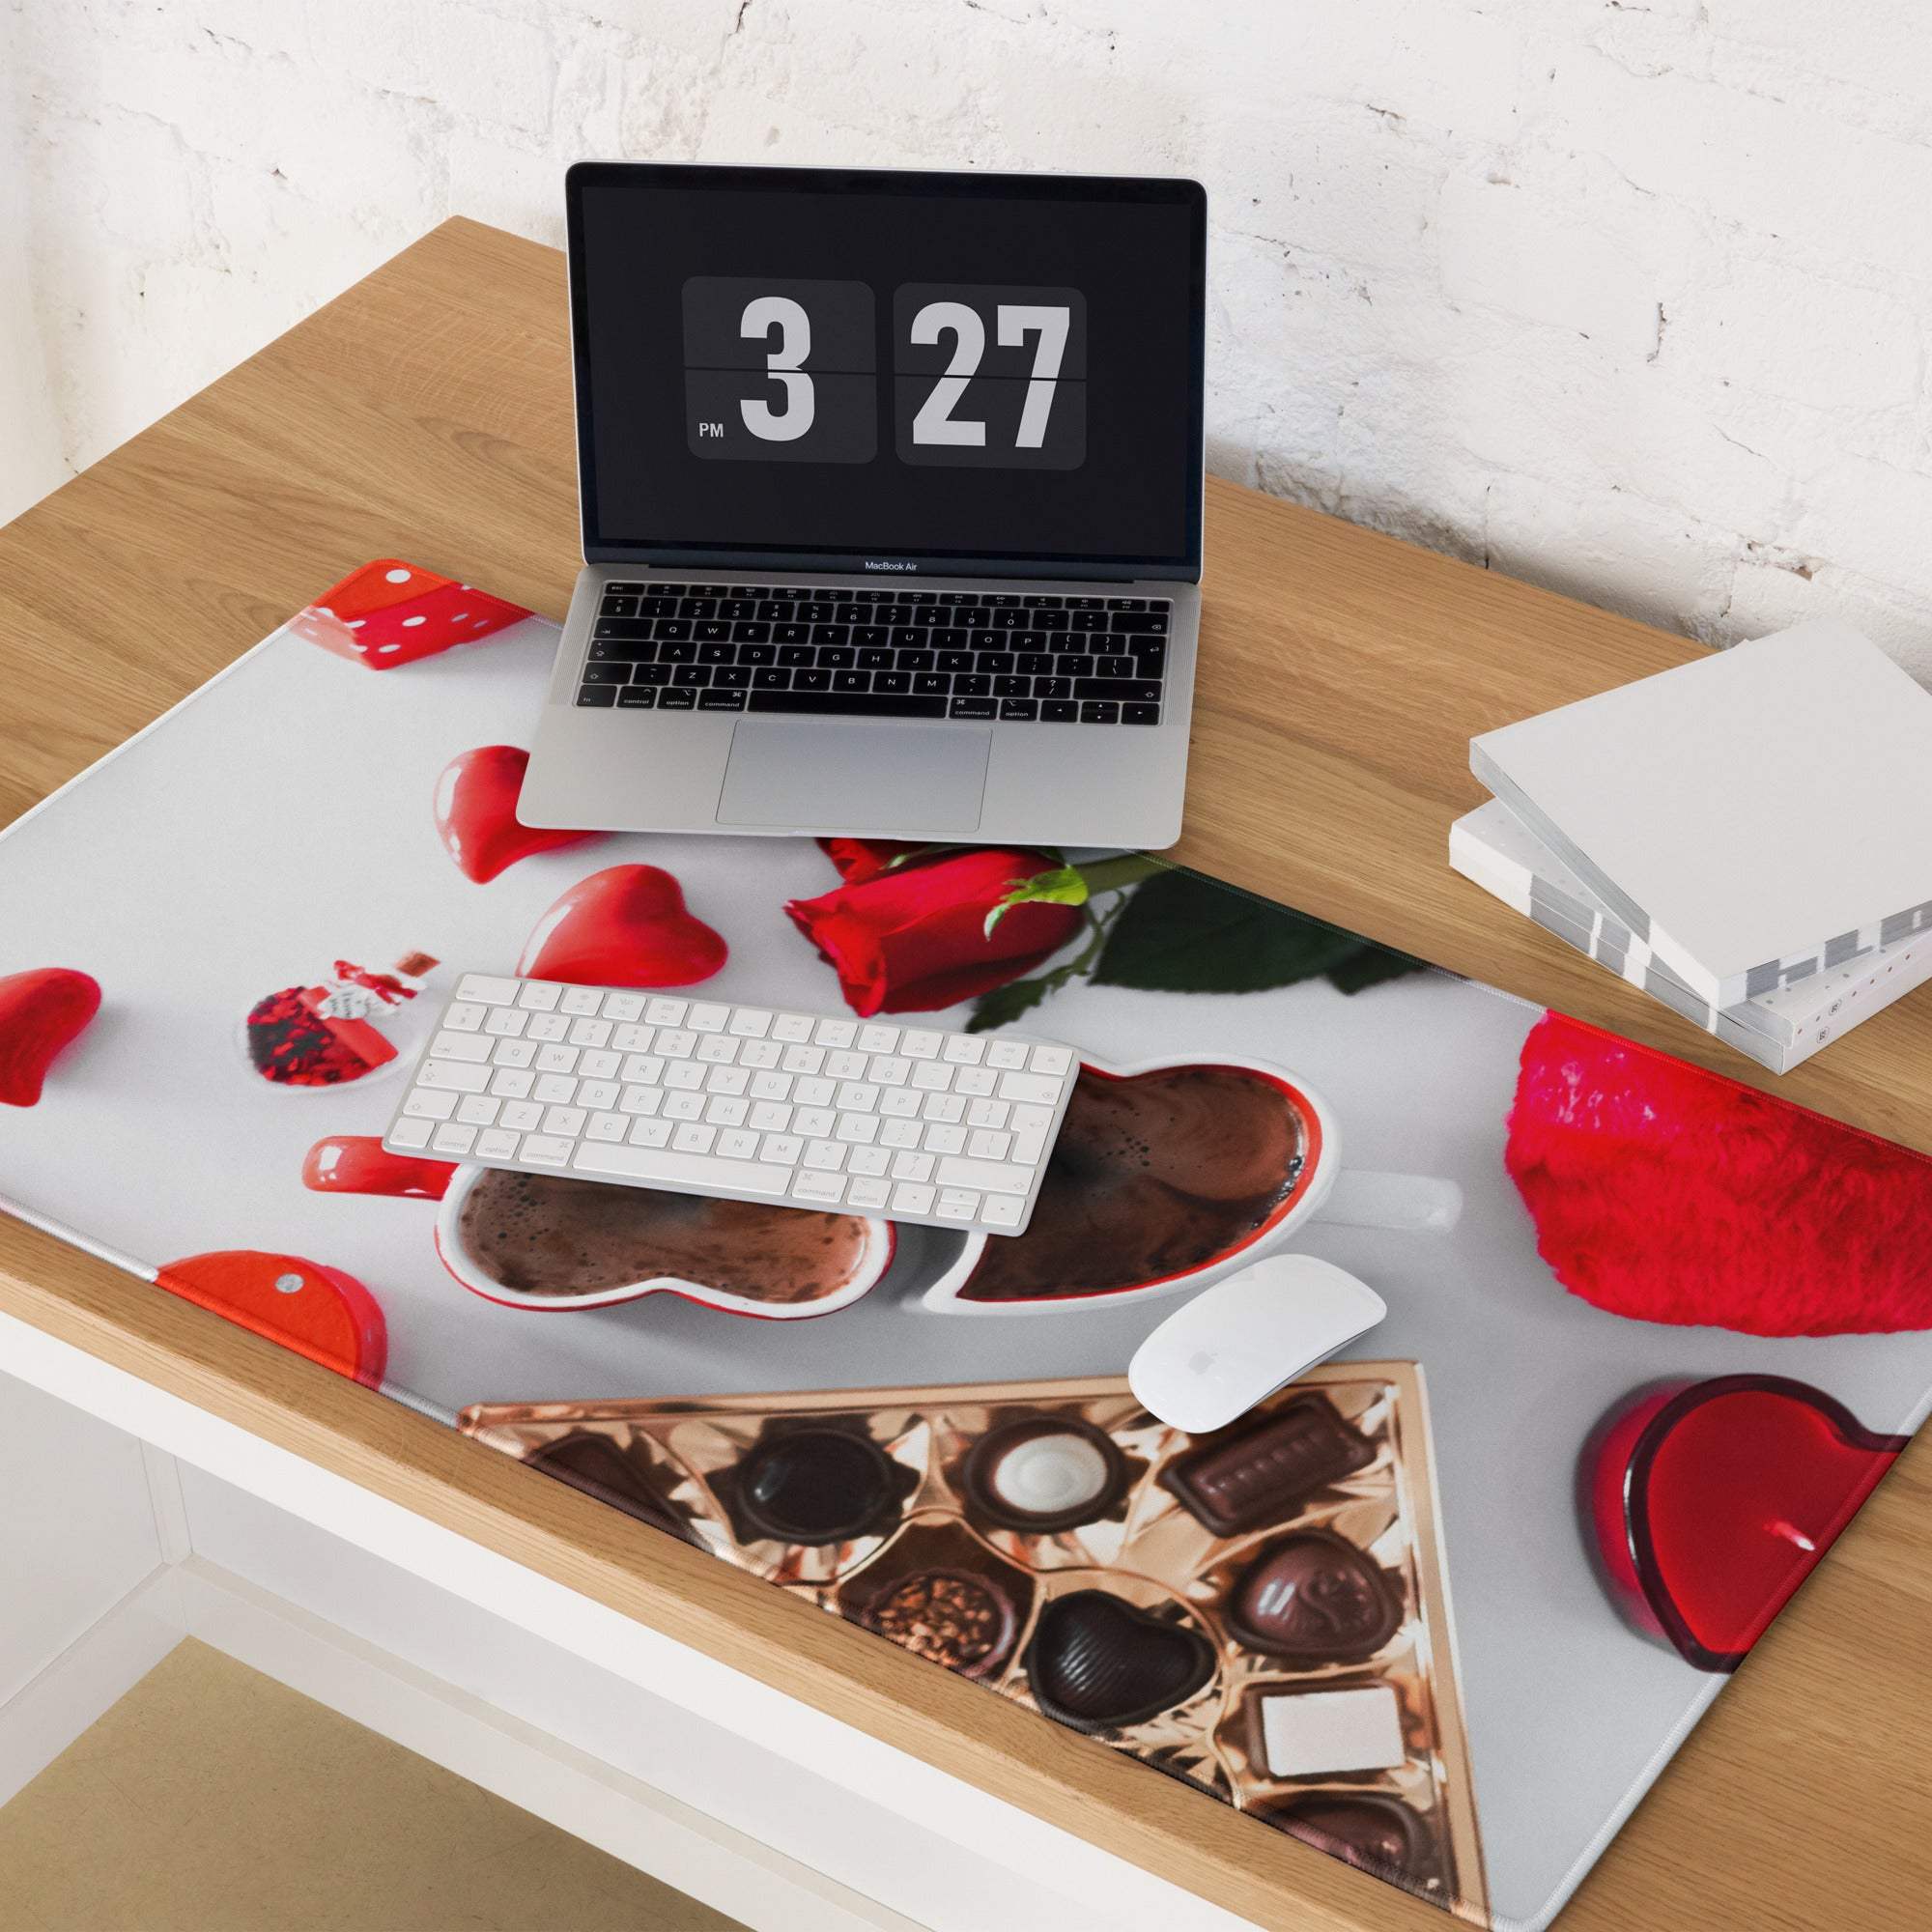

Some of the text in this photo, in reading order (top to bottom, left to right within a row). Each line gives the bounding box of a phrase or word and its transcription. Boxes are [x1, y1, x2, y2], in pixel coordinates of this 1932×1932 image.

[740, 297, 1070, 448] 3 27
[698, 422, 724, 439] PM
[865, 561, 918, 571] MacBook Air
